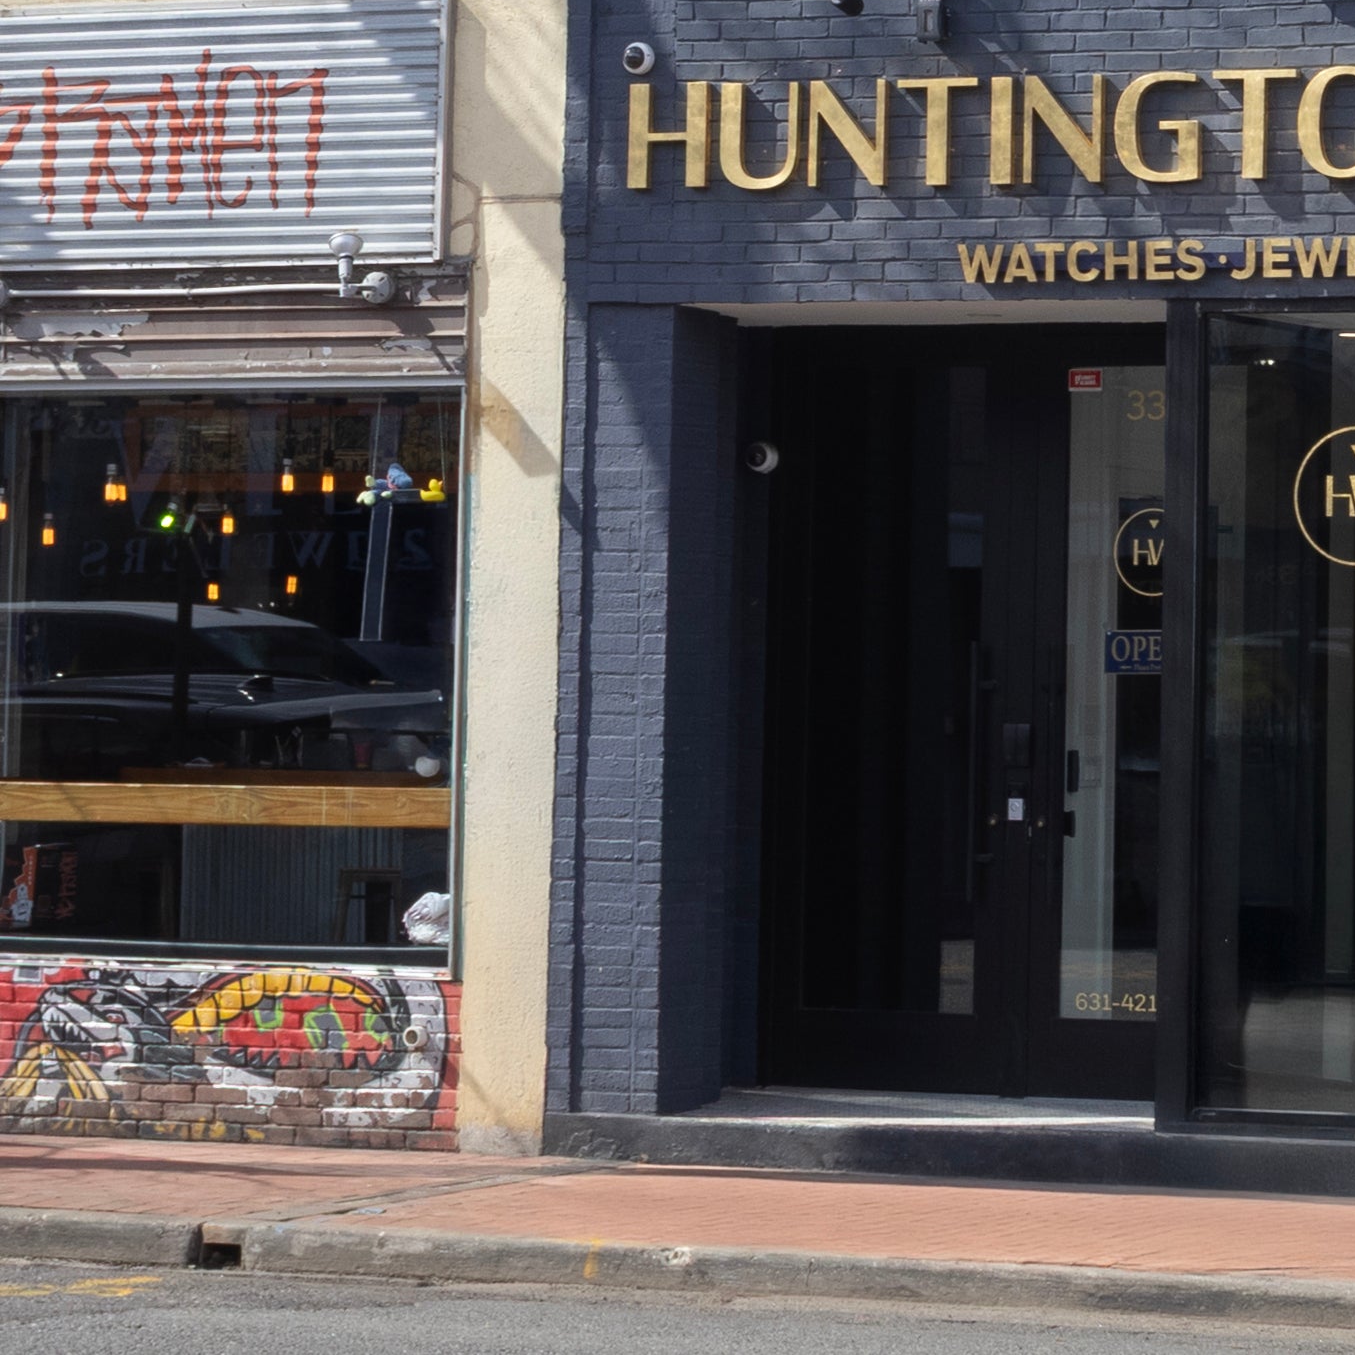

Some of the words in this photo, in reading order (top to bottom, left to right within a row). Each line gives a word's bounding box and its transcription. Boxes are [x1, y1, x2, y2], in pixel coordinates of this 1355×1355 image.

[957, 239, 1206, 284] WATCHES
[1111, 635, 1162, 662] OPE
[1075, 992, 1157, 1013] 631-421
